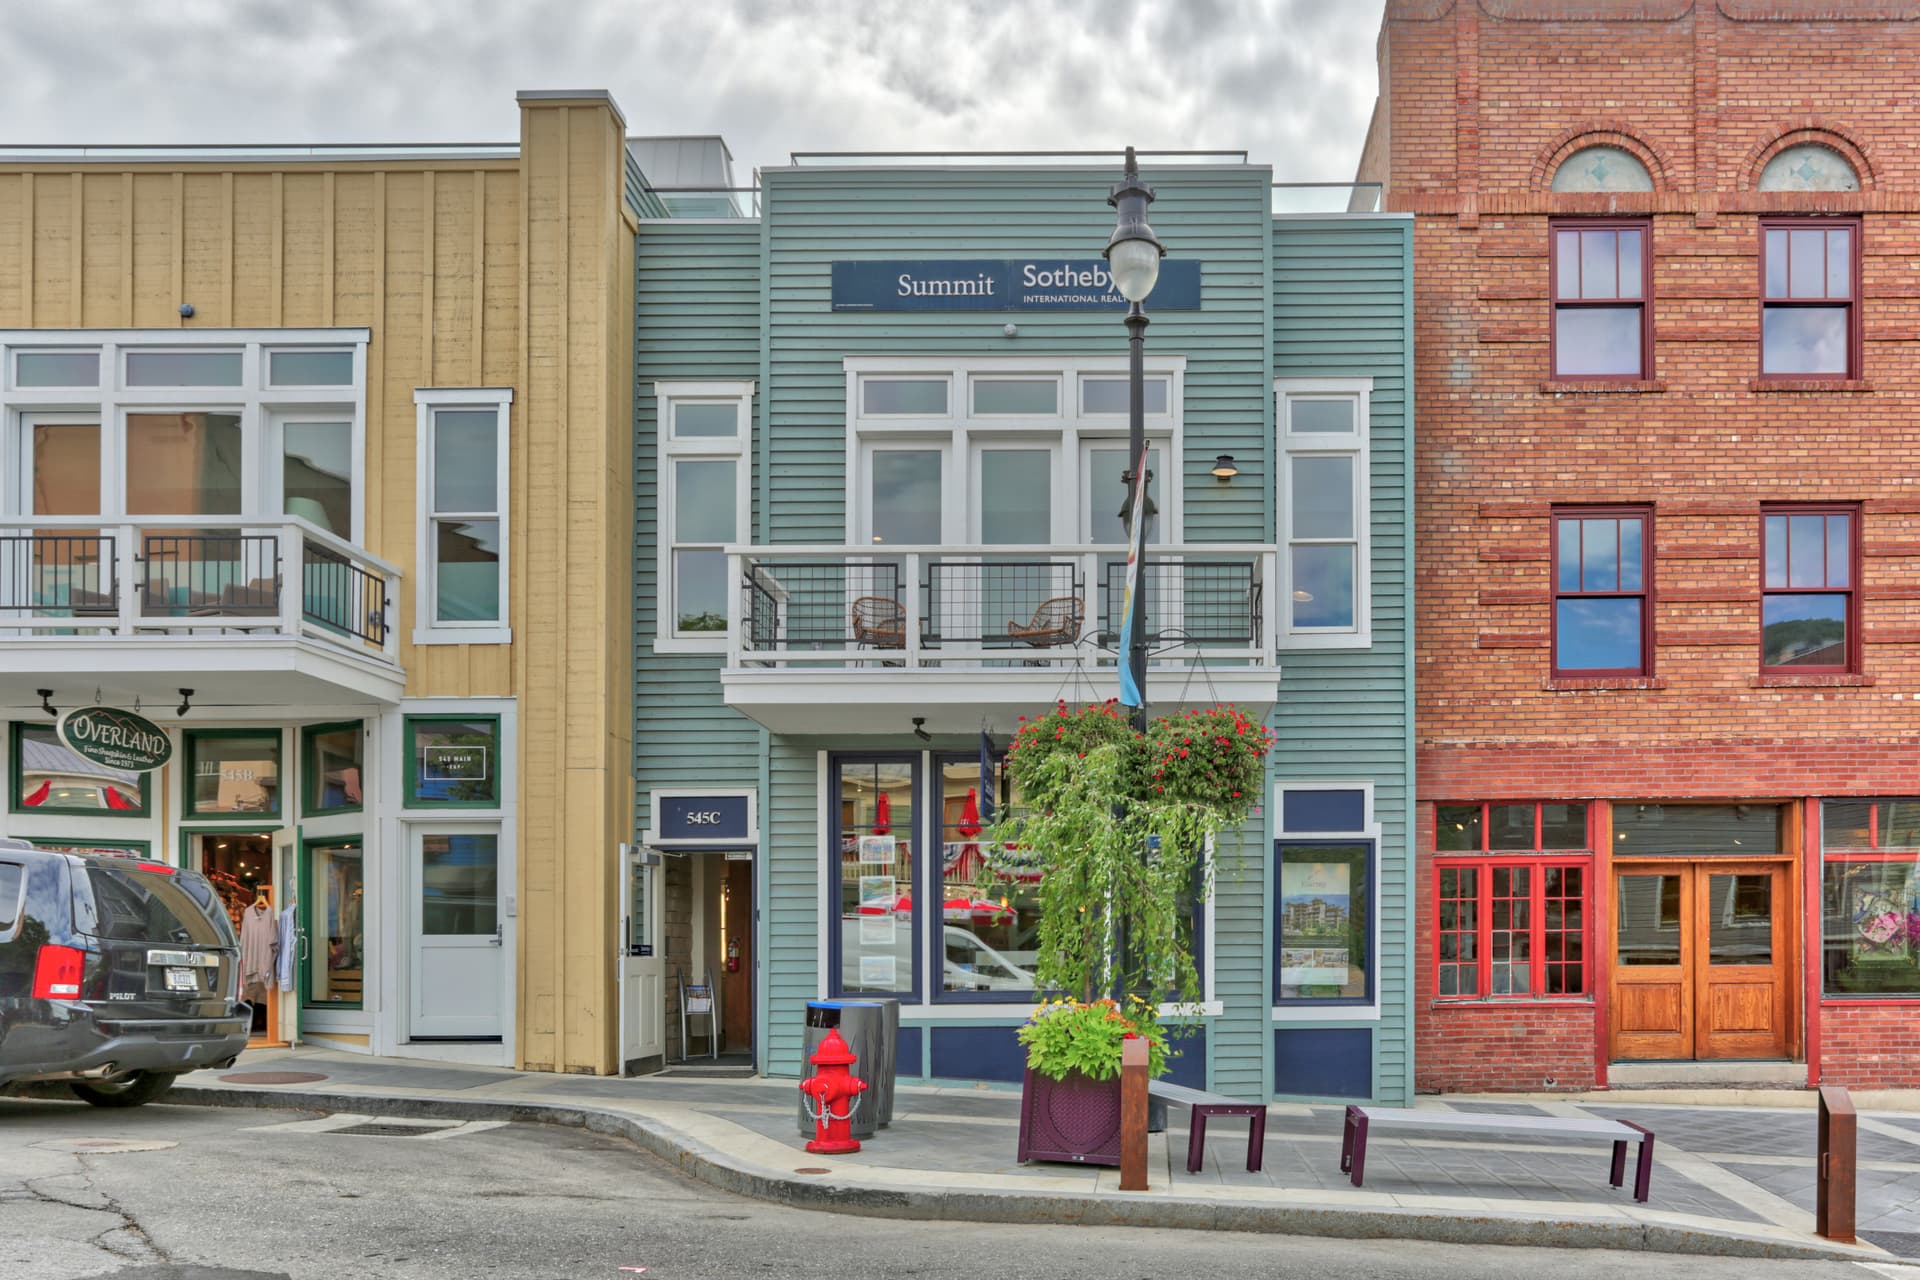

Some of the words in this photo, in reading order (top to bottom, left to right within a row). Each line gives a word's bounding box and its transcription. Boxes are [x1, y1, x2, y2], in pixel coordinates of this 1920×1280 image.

[898, 273, 995, 297] Summit
[1023, 264, 1117, 293] Sotheby
[1023, 295, 1098, 303] INTERNATIONAL
[1101, 295, 1127, 303] REALT
[73, 715, 165, 754] OVERLAND
[84, 745, 98, 753] Fine
[133, 753, 154, 764] Leather
[104, 757, 121, 765] Since
[687, 811, 721, 824] 545C
[109, 992, 137, 1000] PILOT
